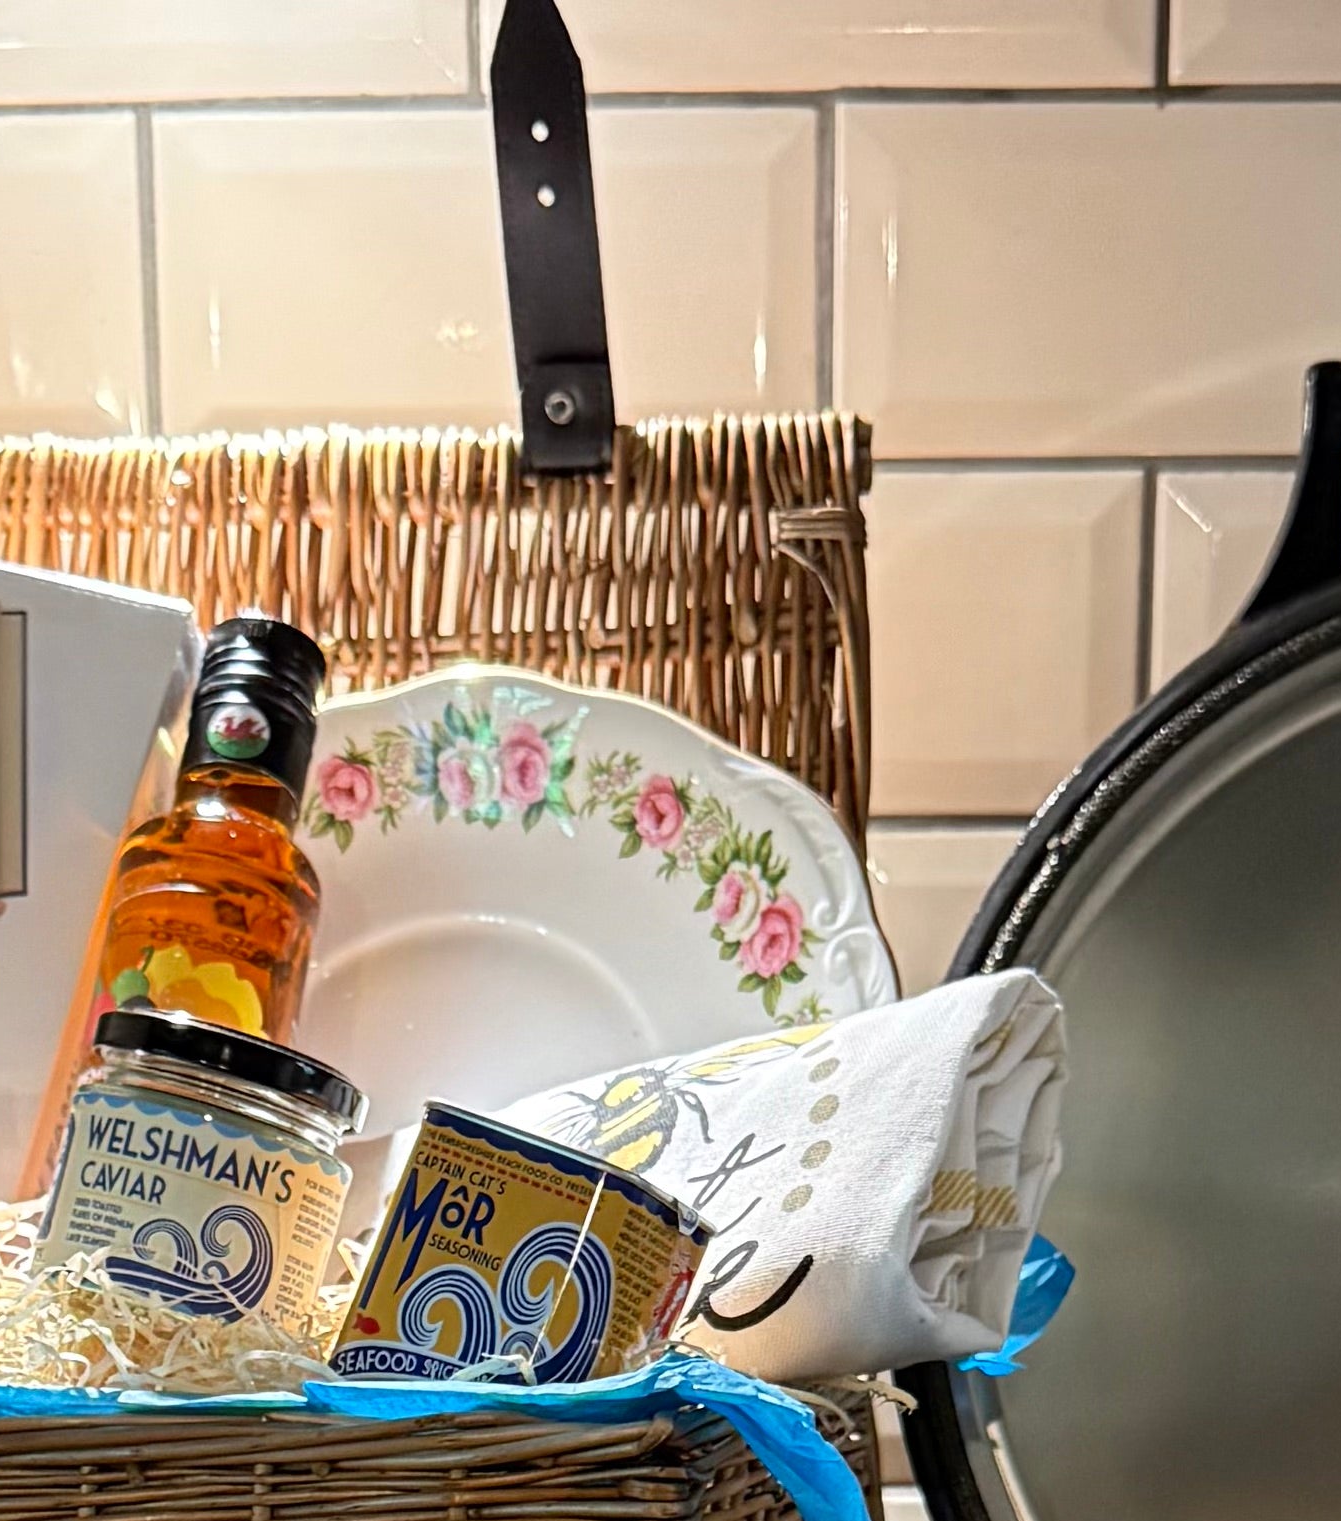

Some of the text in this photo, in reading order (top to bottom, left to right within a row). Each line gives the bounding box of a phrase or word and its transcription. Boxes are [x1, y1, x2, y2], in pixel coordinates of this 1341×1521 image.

[87, 1115, 295, 1204] WELSHMAN'S
[414, 1151, 507, 1195] CAPTAIN CAT'S
[521, 1164, 548, 1181] FOOD
[80, 1160, 167, 1205] CAVIAR
[428, 1232, 503, 1272] SEASONING
[336, 1349, 418, 1374] SEAFOOD
